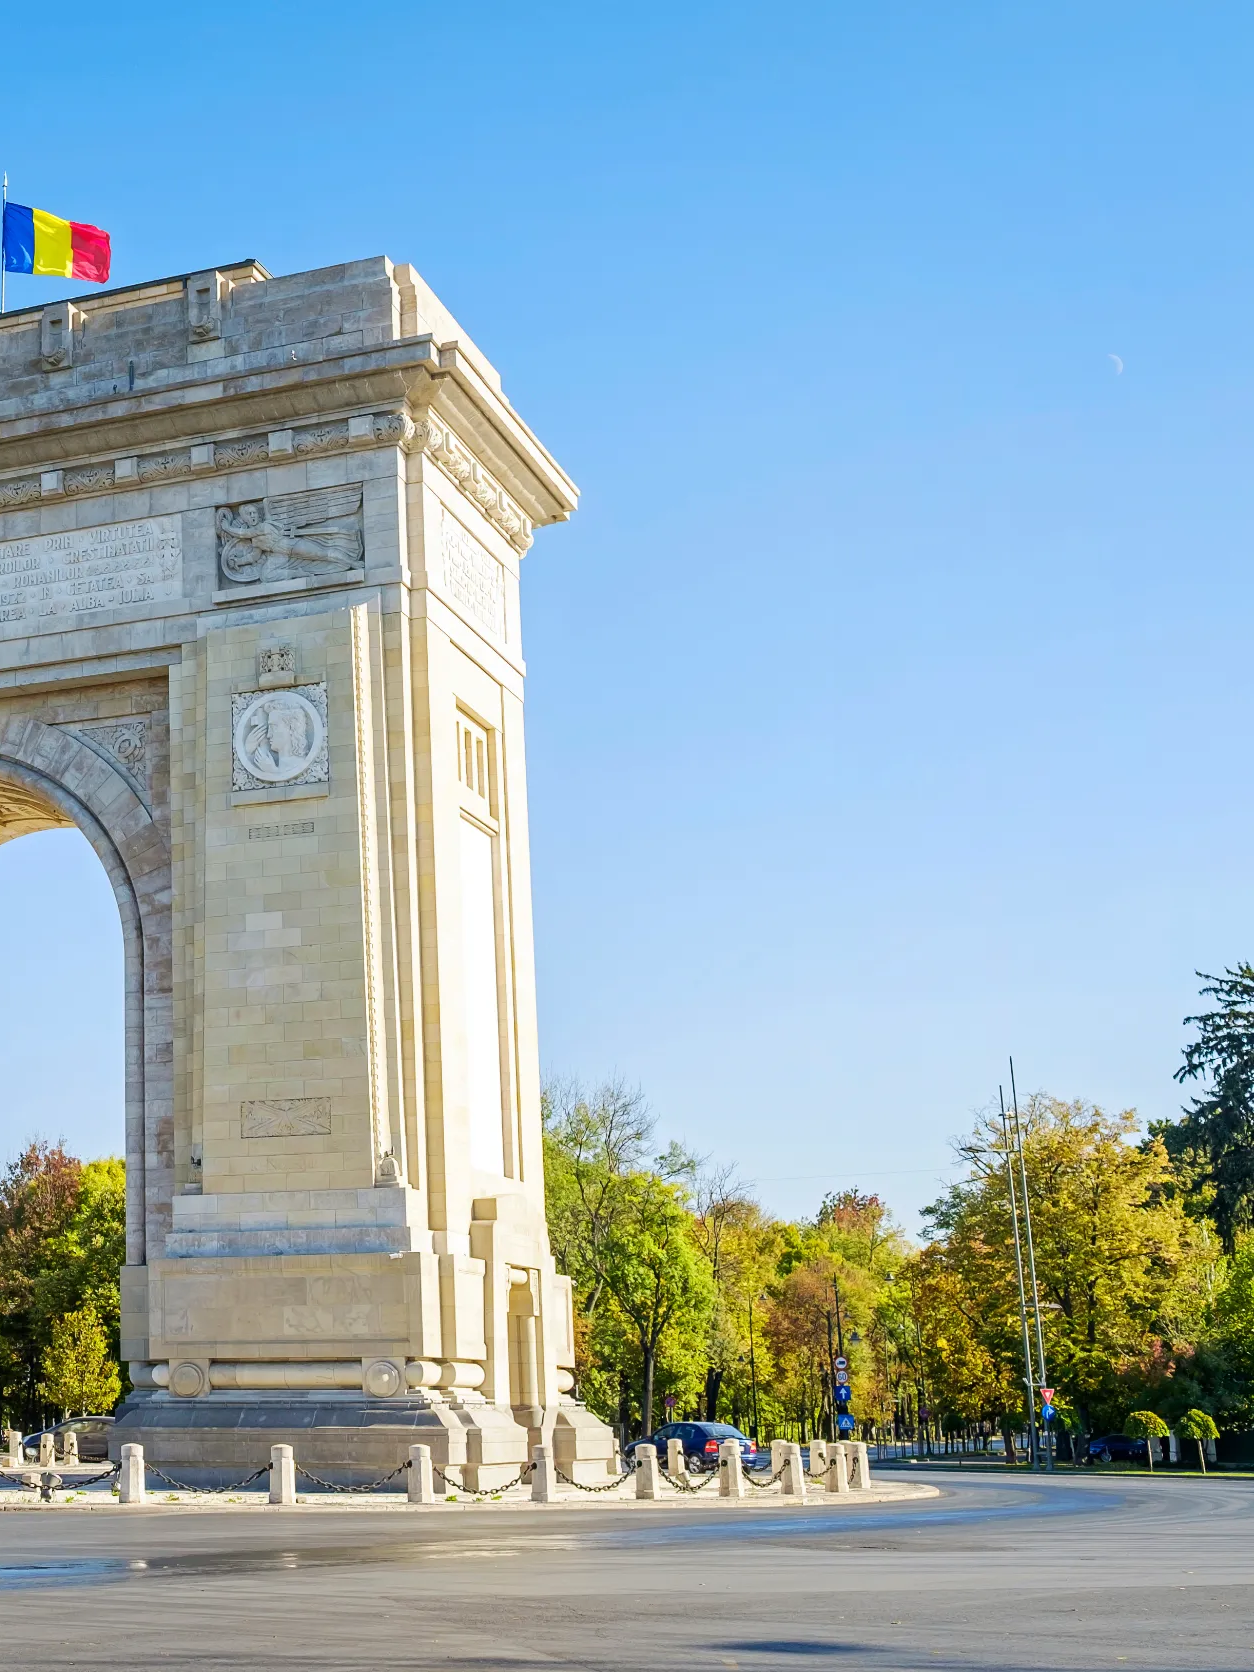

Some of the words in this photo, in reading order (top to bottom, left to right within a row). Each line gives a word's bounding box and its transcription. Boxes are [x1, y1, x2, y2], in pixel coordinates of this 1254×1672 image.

[46, 536, 74, 553] PRIN
[88, 523, 154, 545] VIRTUTEA
[0, 592, 26, 607] 1922
[41, 587, 51, 601] IN
[67, 575, 125, 596] CETATEA
[138, 573, 155, 586] SA
[13, 567, 84, 589] ROMANILOR
[40, 603, 57, 617] LA
[70, 595, 105, 613] ALBA
